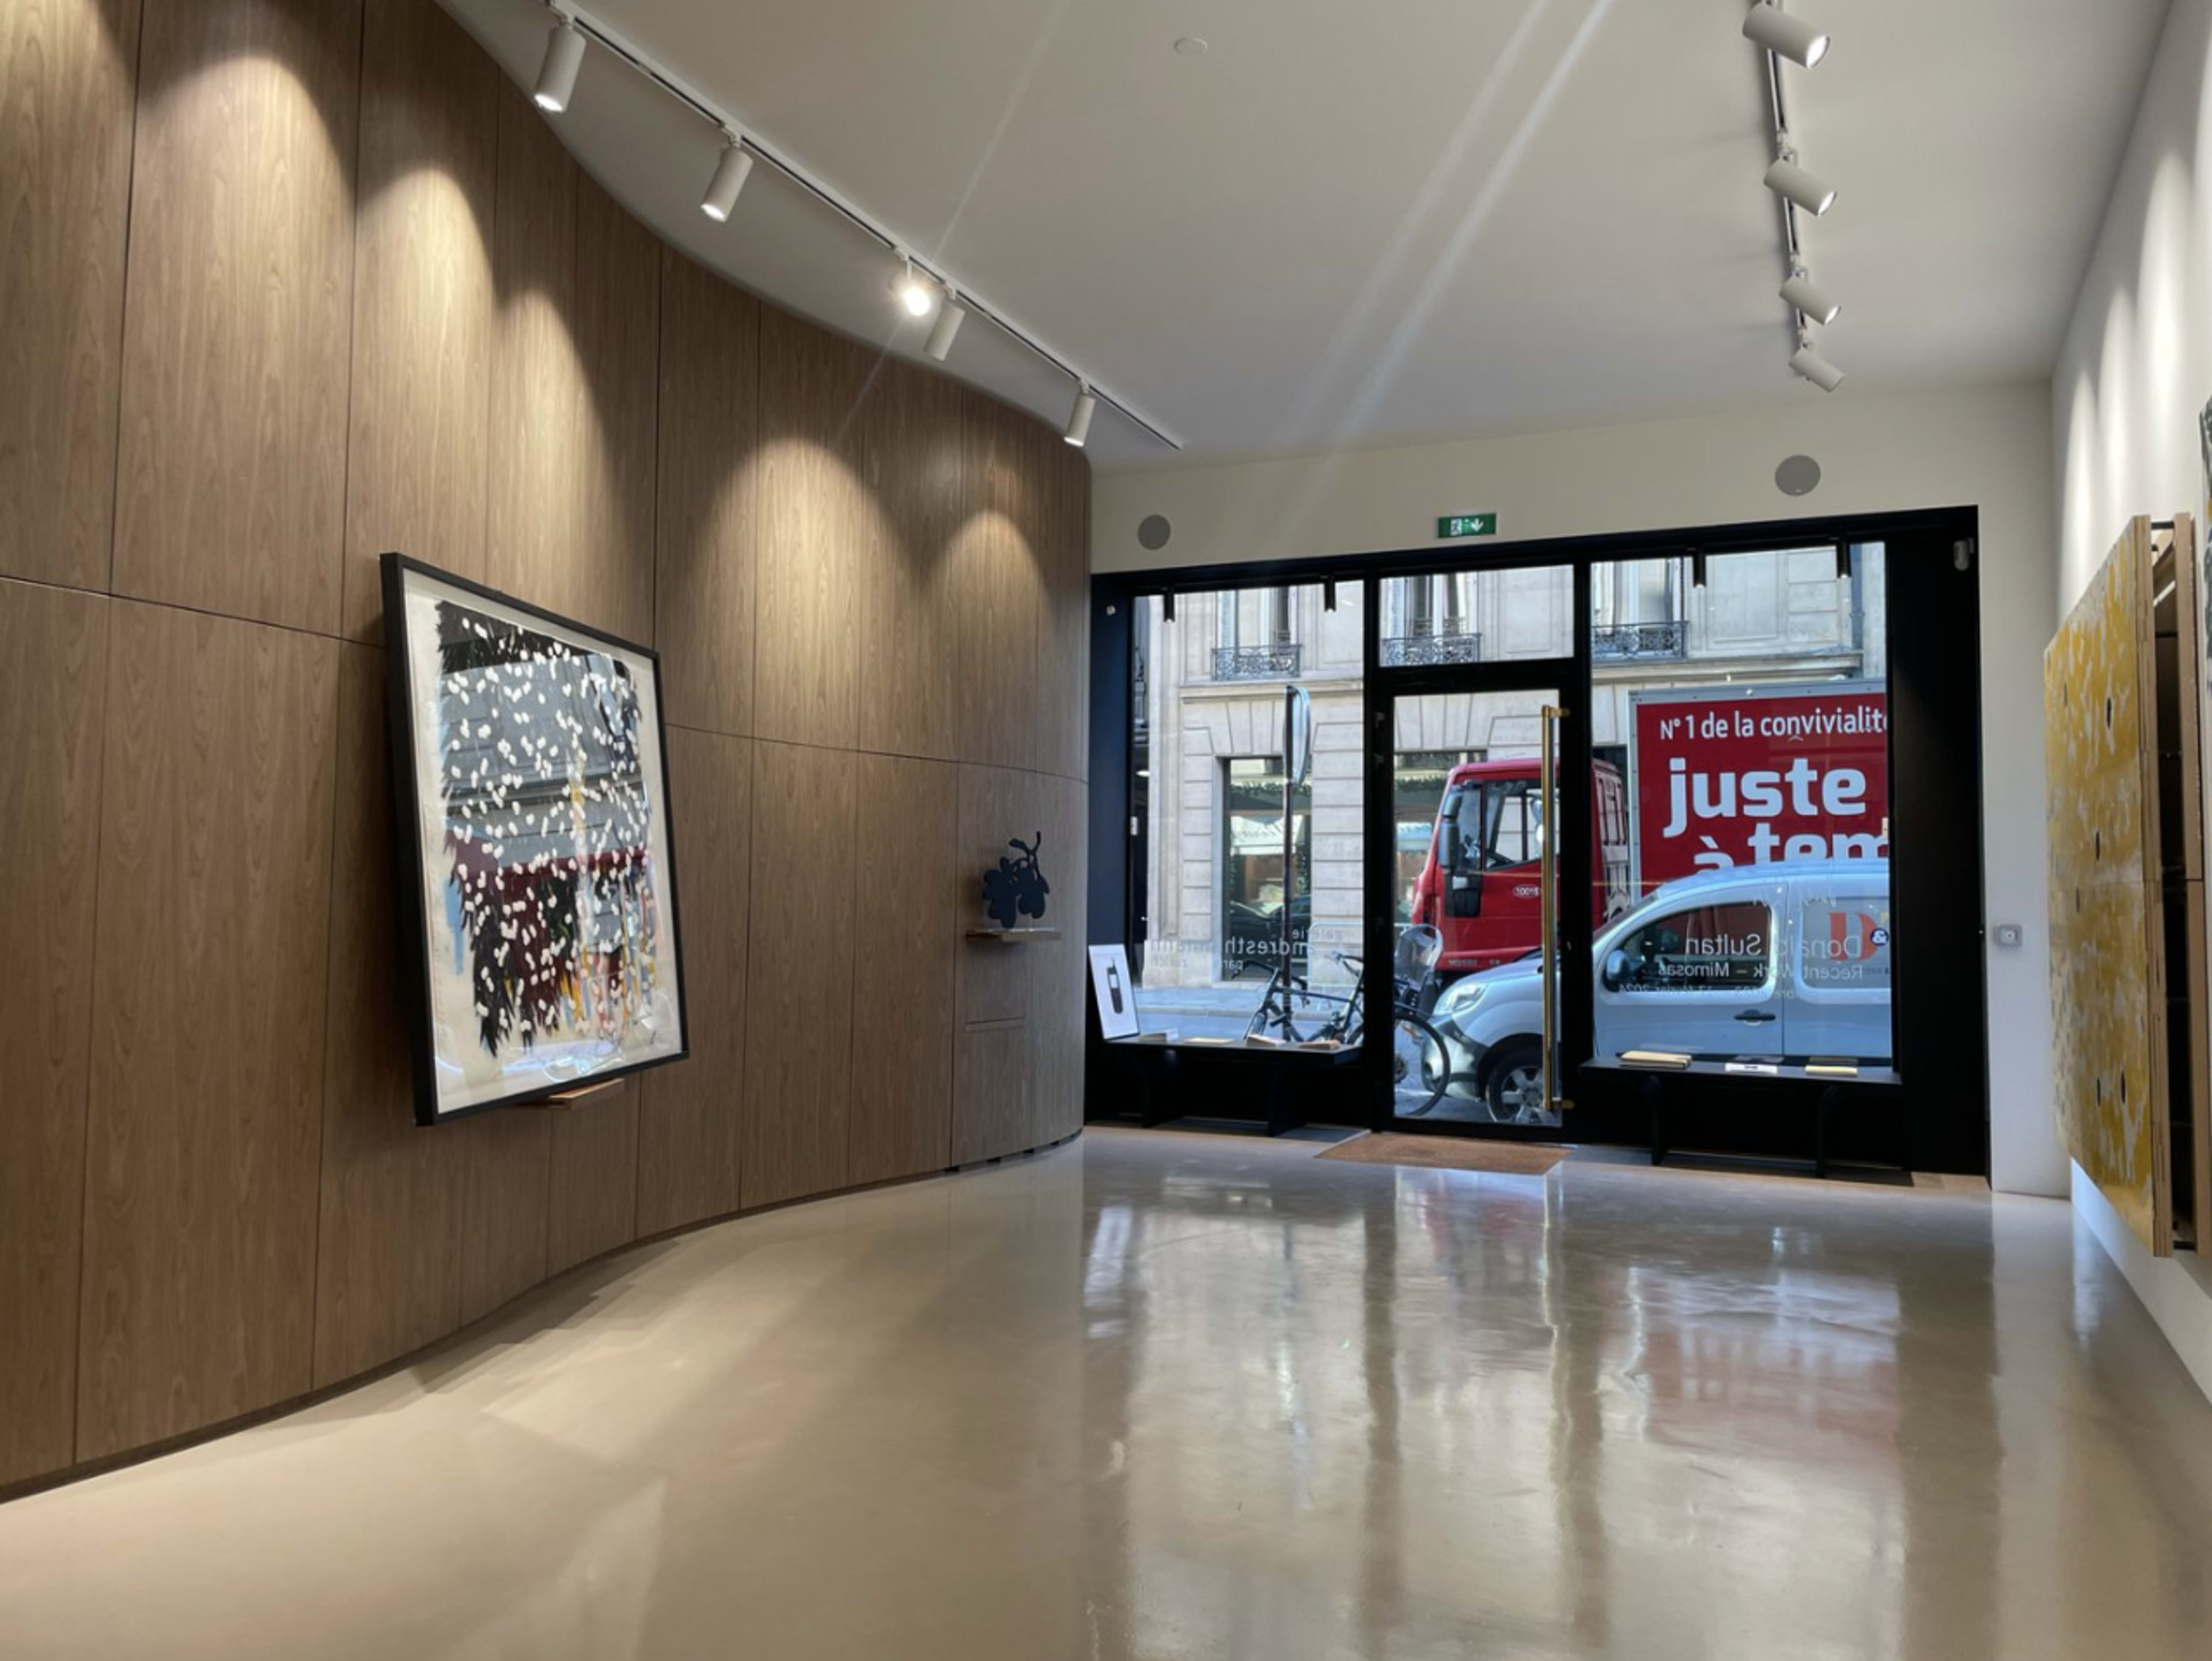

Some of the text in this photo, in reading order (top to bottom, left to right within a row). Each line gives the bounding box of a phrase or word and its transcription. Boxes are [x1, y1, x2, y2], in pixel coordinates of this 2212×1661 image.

[1685, 714, 1695, 739] 1
[1701, 712, 1728, 739] de
[1734, 710, 1754, 737] la
[1662, 757, 1866, 838] juste
